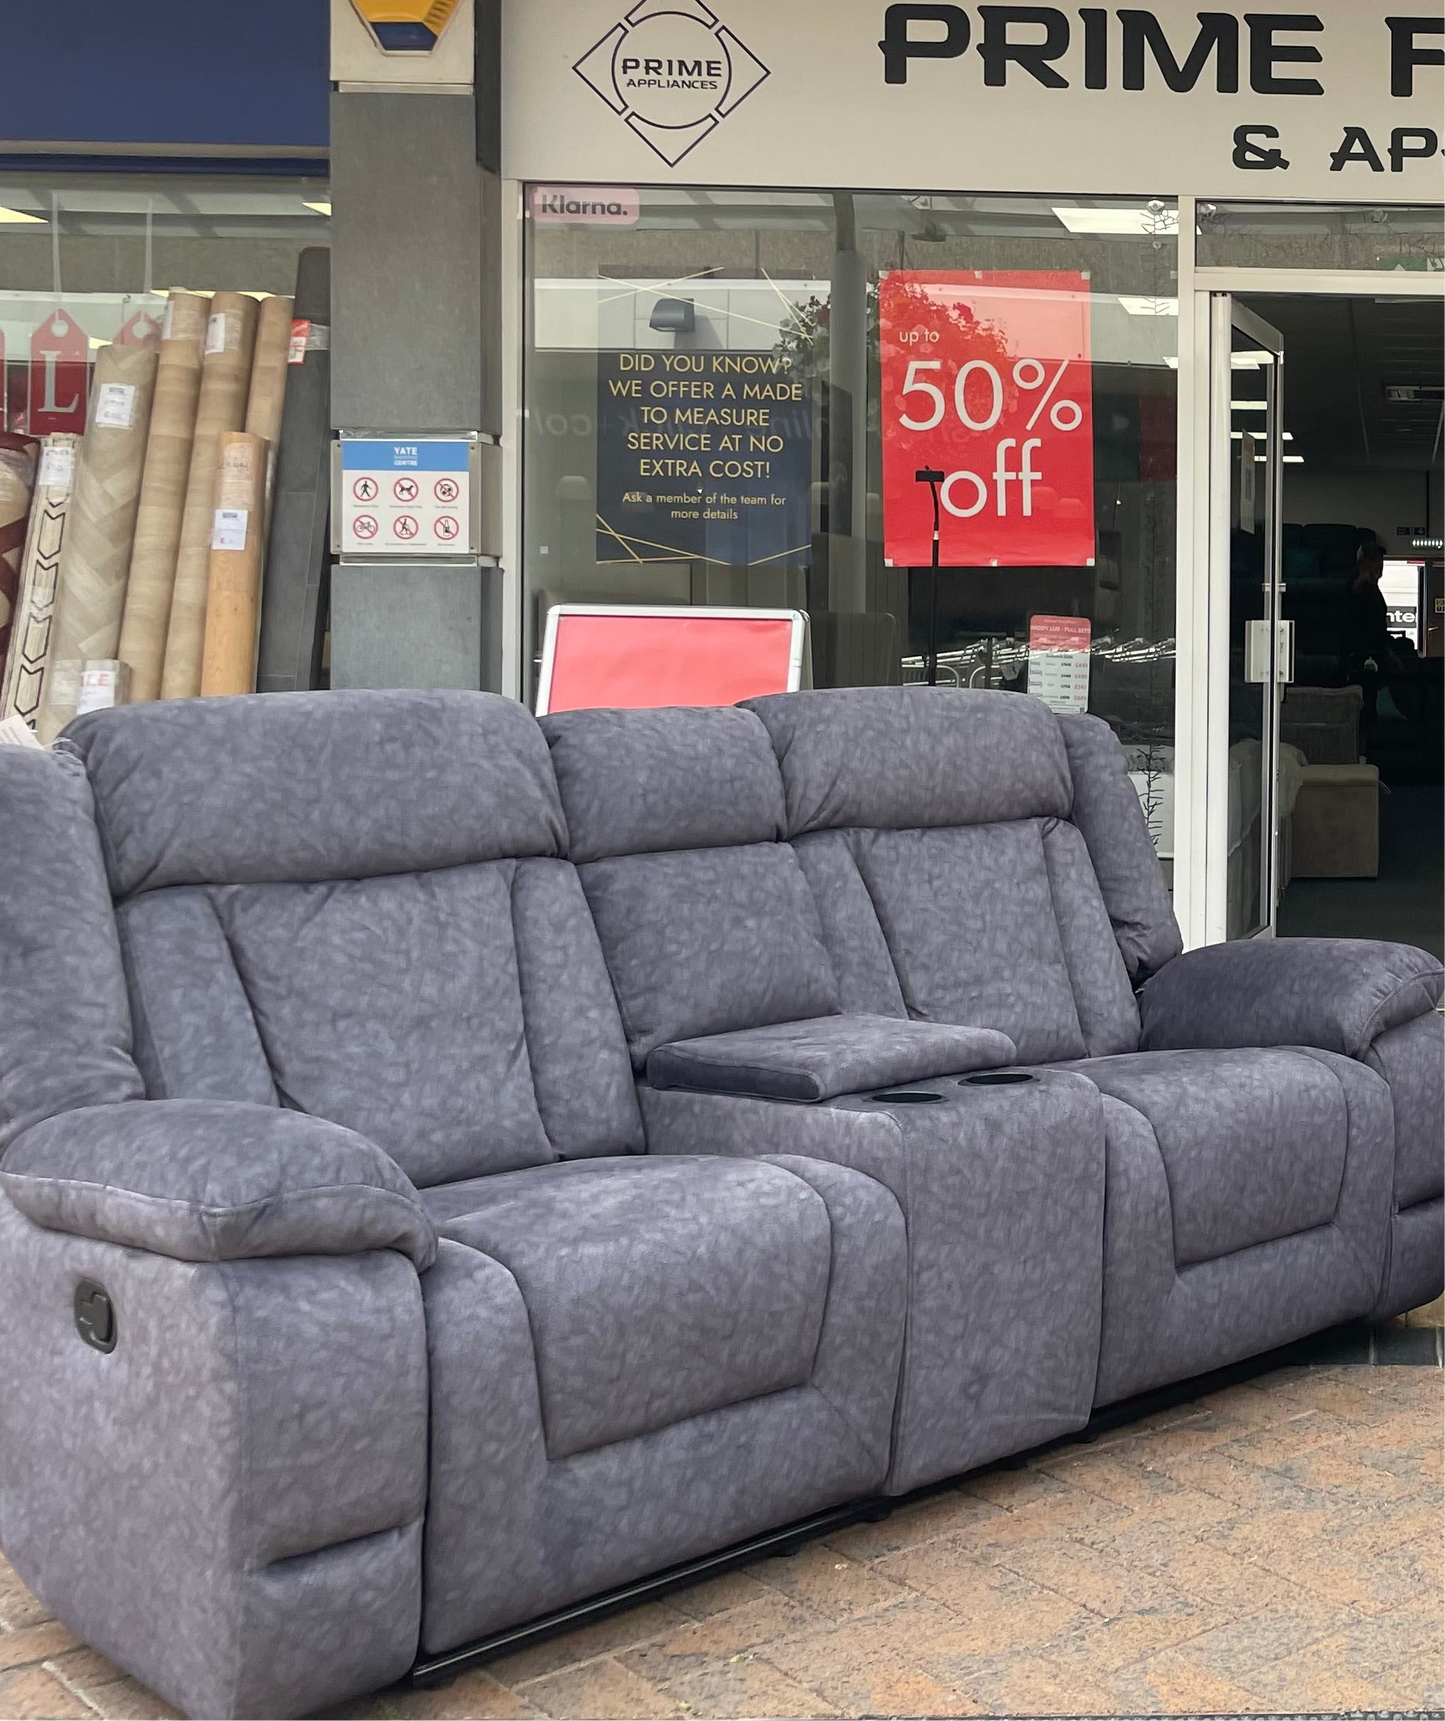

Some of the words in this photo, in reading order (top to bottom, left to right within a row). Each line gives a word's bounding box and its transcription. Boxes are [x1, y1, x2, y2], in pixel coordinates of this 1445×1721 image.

[878, 3, 1325, 95] PRIME
[621, 58, 723, 77] PRIME
[626, 78, 718, 90] APPLIANCES
[1232, 124, 1290, 170] &
[541, 194, 628, 216] Klarna.
[899, 331, 919, 344] up
[925, 328, 940, 343] to
[619, 353, 655, 372] DID
[662, 354, 704, 373] YOU
[712, 356, 792, 375] KNOW?
[38, 350, 80, 413] L
[608, 380, 642, 397] WE
[650, 380, 715, 399] OFFER
[721, 383, 736, 399] A
[743, 383, 803, 401] MADE
[899, 358, 1083, 432] 50%
[640, 406, 667, 424] TO
[674, 408, 770, 426] MEASURE
[394, 447, 418, 455] YATE
[627, 432, 711, 451] SERVICE
[718, 435, 743, 451] AT
[750, 435, 784, 453] NO
[640, 459, 702, 477] EXTRA
[709, 461, 771, 478] COST!
[940, 438, 1042, 517] off
[622, 493, 643, 503] Ask
[646, 495, 653, 503] a
[656, 493, 702, 503] member
[705, 493, 717, 504] of
[720, 493, 737, 504] the
[740, 496, 767, 505] team
[770, 494, 786, 505] for
[671, 510, 699, 519] more
[703, 509, 738, 520] details
